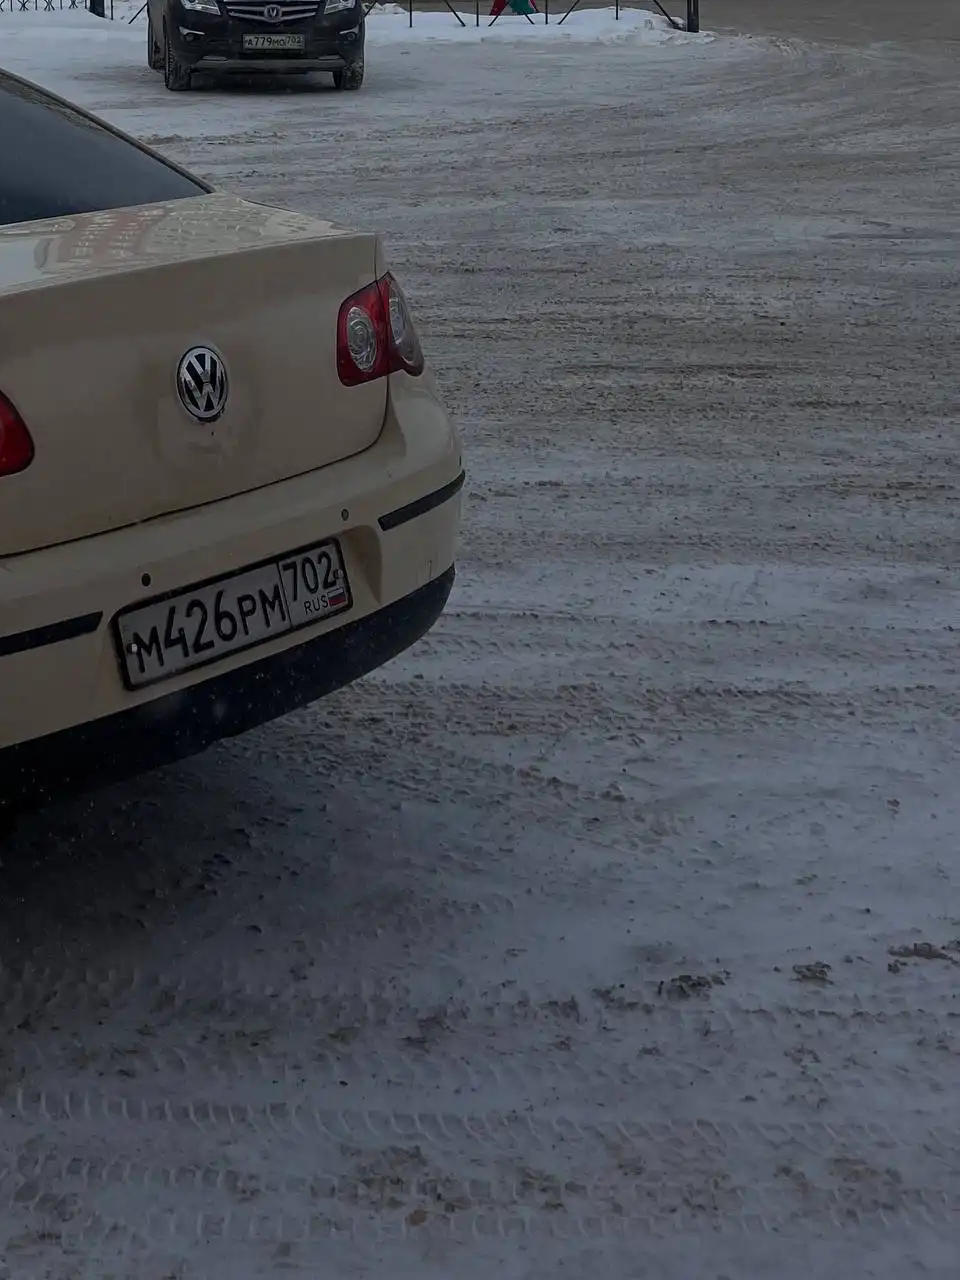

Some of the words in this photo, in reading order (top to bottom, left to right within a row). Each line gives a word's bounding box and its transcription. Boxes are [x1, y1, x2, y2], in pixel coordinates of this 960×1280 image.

[132, 582, 289, 673] М426РМ
[281, 550, 337, 602] 702
[304, 596, 329, 615] RUS
